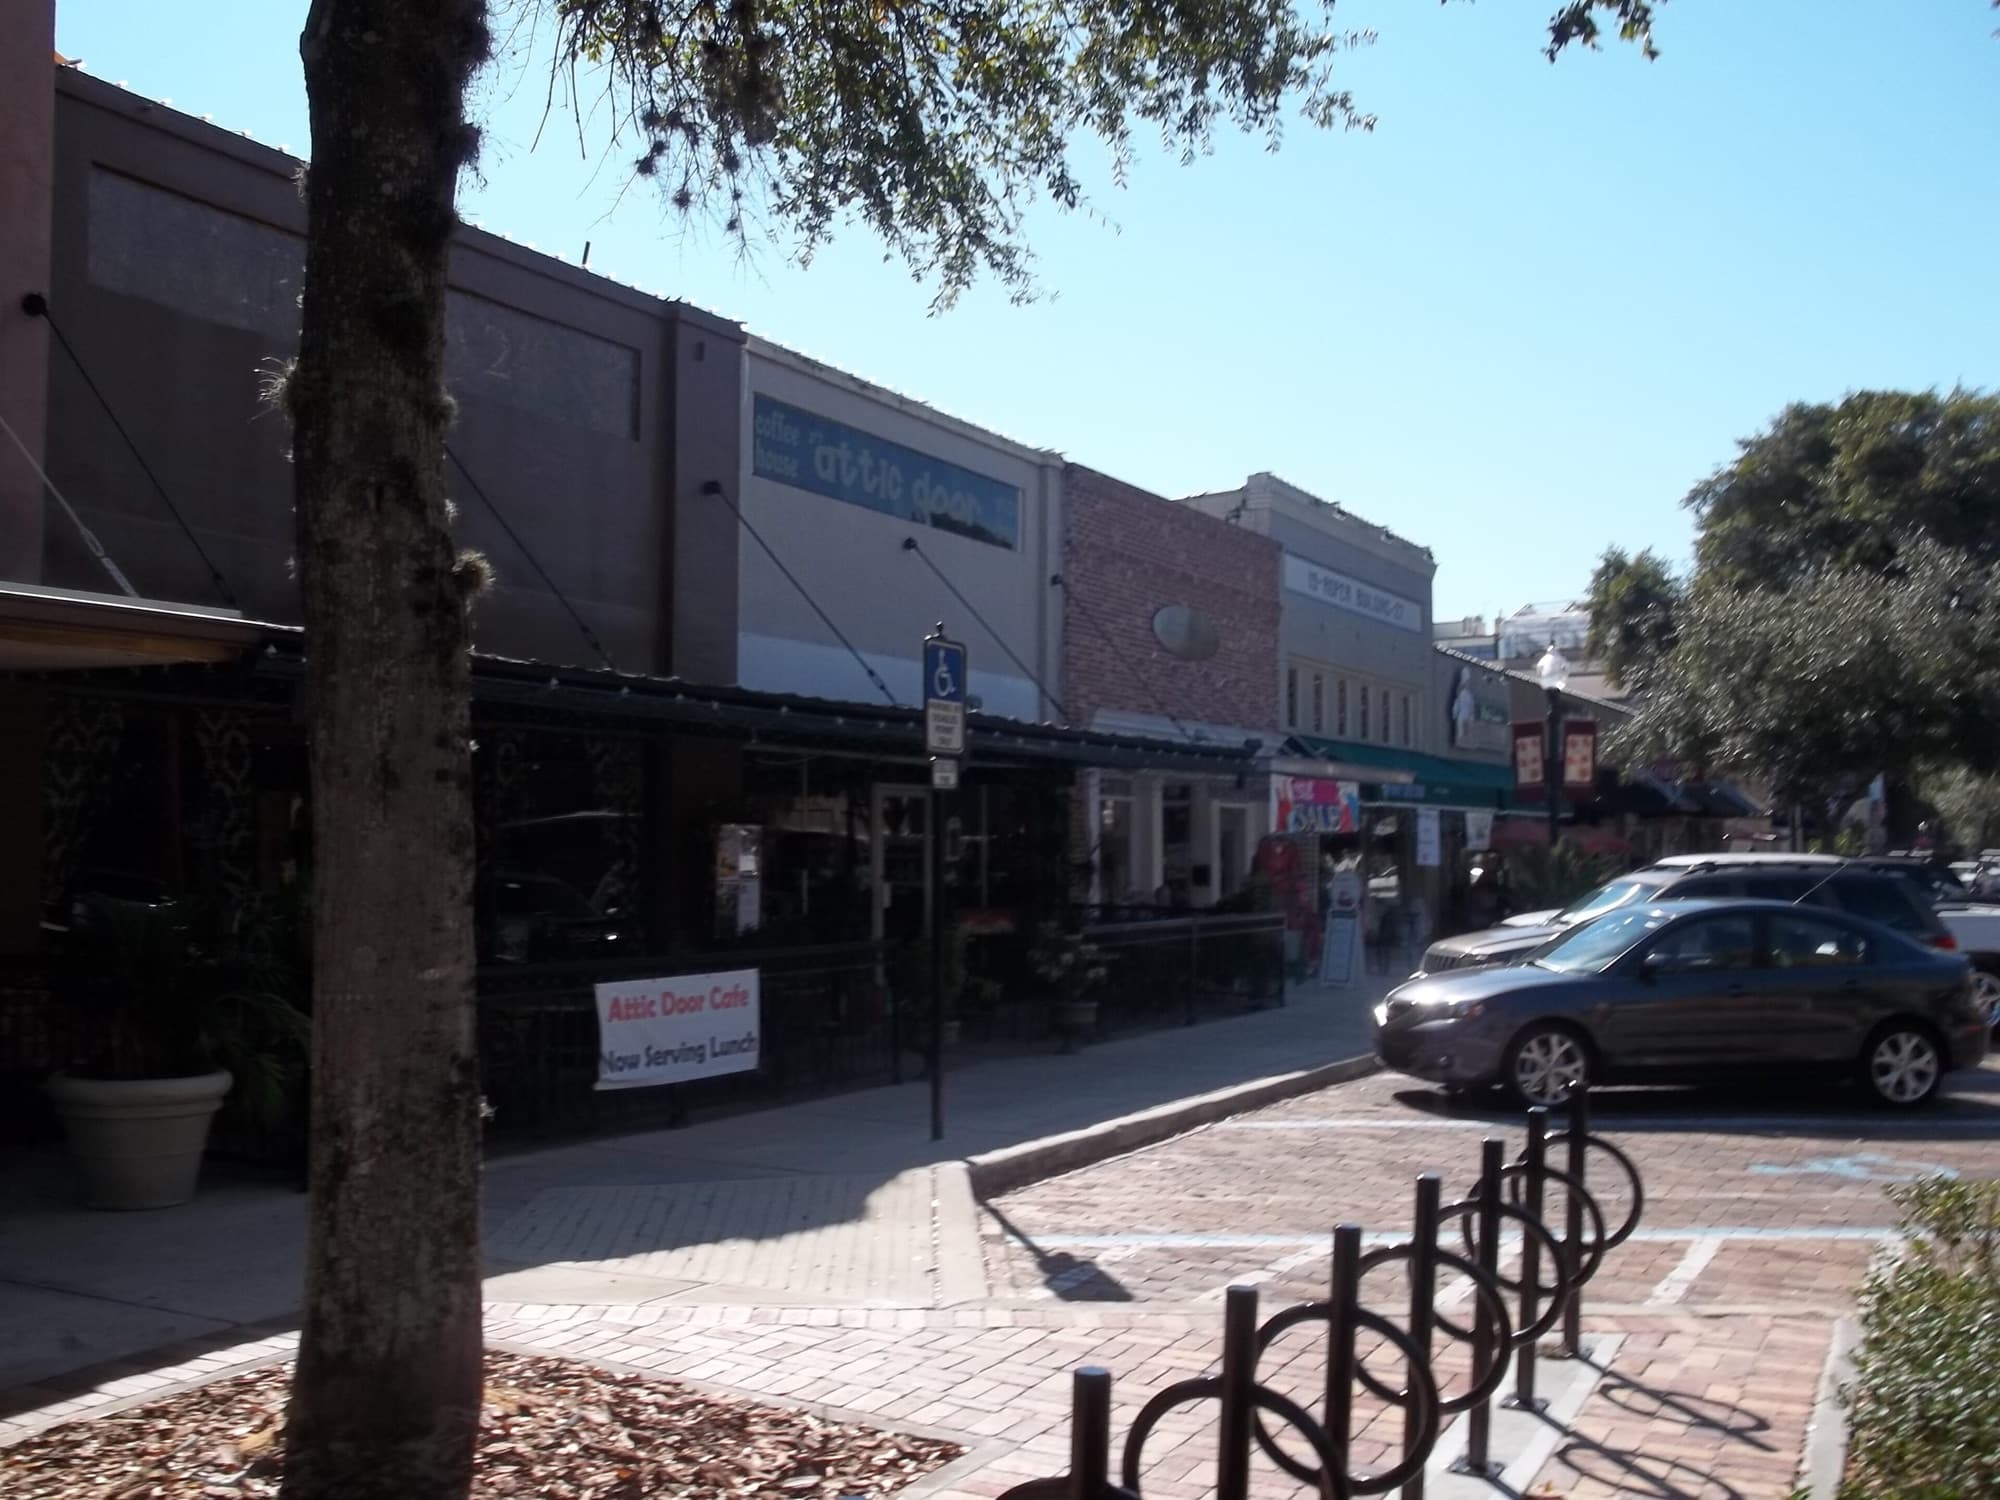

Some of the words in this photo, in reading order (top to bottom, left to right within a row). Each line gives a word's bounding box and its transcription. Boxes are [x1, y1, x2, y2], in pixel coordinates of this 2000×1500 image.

[814, 443, 904, 501] attic
[608, 995, 656, 1022] Attic
[661, 991, 704, 1016] Door
[645, 1044, 706, 1068] Serving
